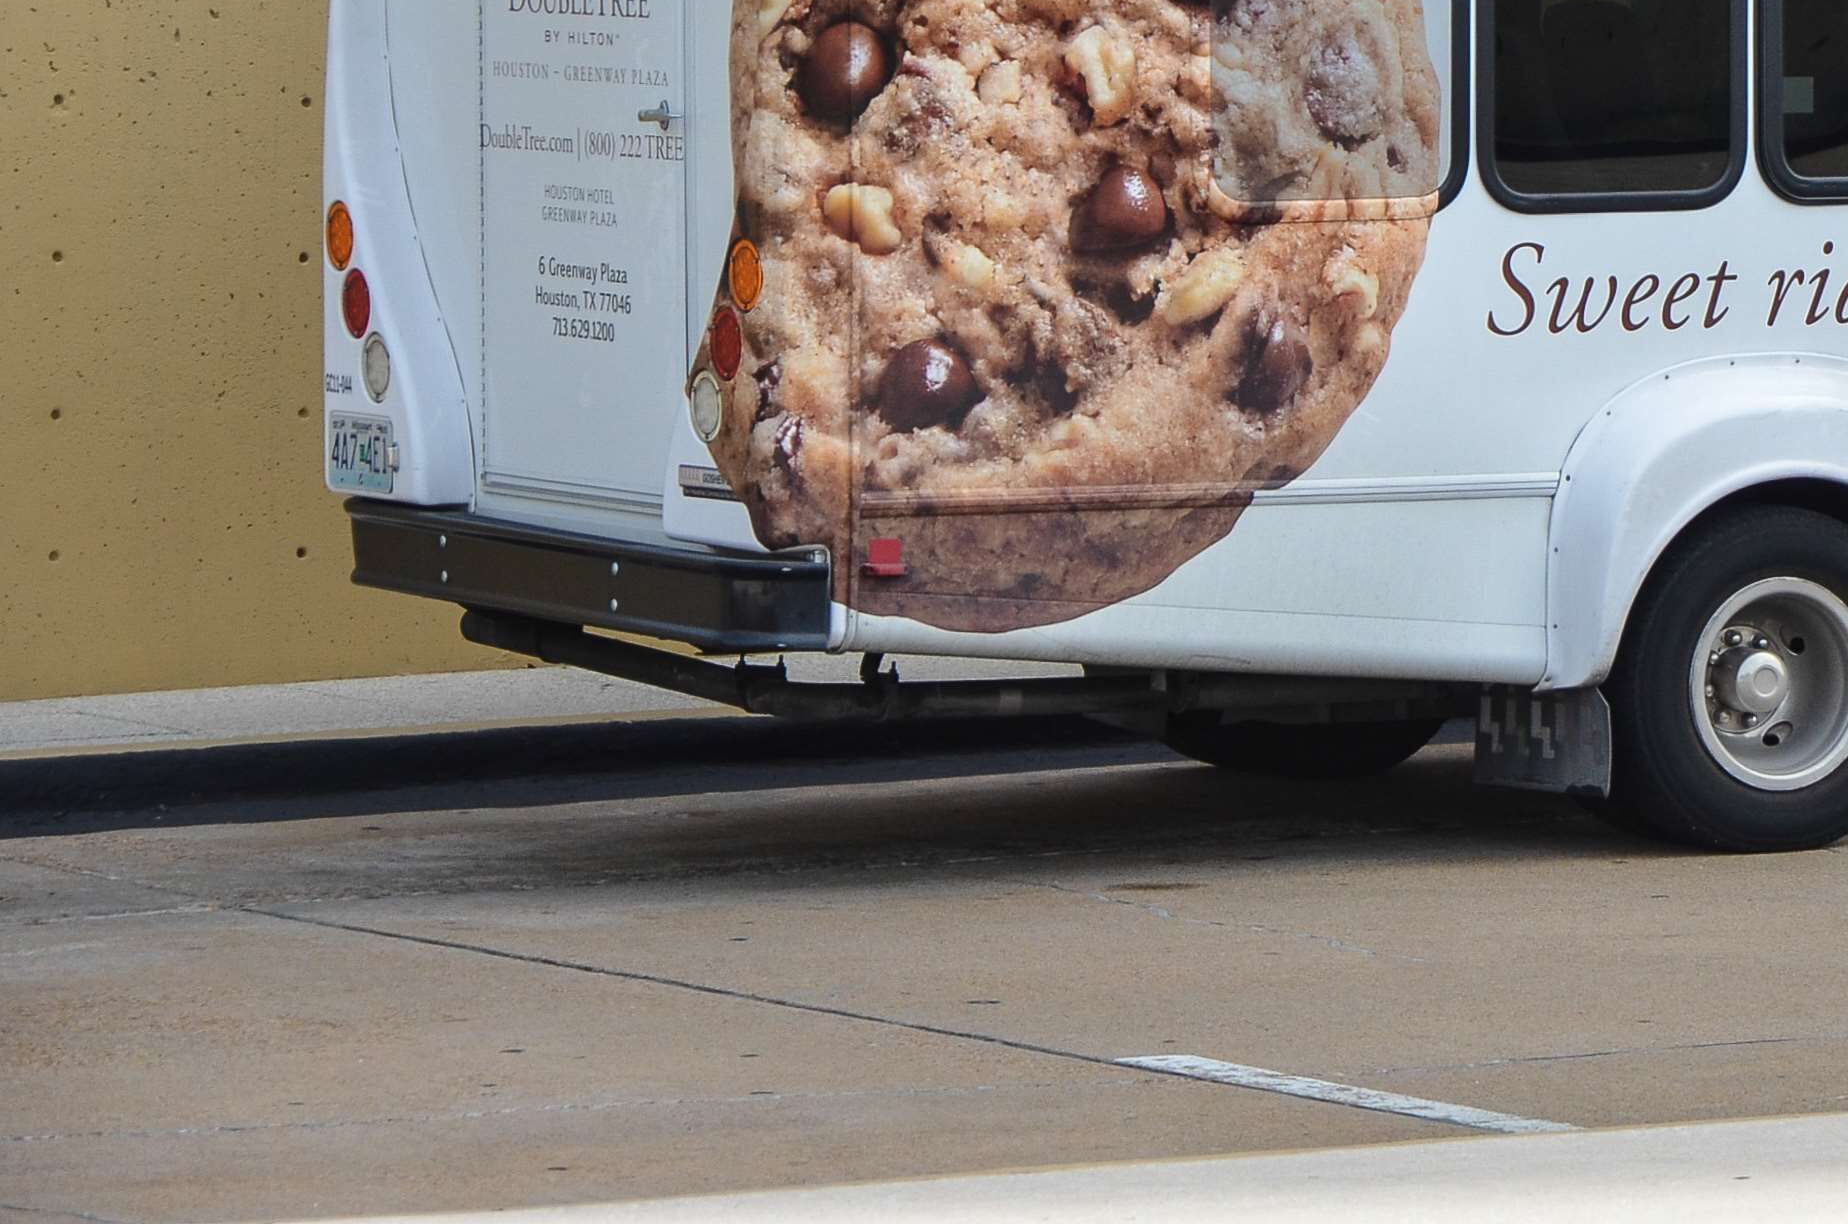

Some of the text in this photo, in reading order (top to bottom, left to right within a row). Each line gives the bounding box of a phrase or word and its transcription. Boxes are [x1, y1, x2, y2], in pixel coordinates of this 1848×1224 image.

[544, 30, 559, 43] BY
[492, 61, 550, 79] HOUSTON
[563, 67, 627, 85] GREENWAY
[631, 69, 669, 87] PLAZA
[480, 123, 574, 154] DoubleTree.com
[584, 129, 616, 161] (800)
[619, 134, 642, 159] 222
[645, 134, 684, 161] TREE
[544, 184, 615, 205] HOUSTON HOTEL
[541, 206, 618, 227] GREENWAY PLAZA
[538, 256, 628, 286] 6 Greenway Plaza
[535, 285, 632, 315] Houston, TX 77046
[1487, 242, 1738, 336] Sweet
[552, 316, 615, 343] 713.629.1200
